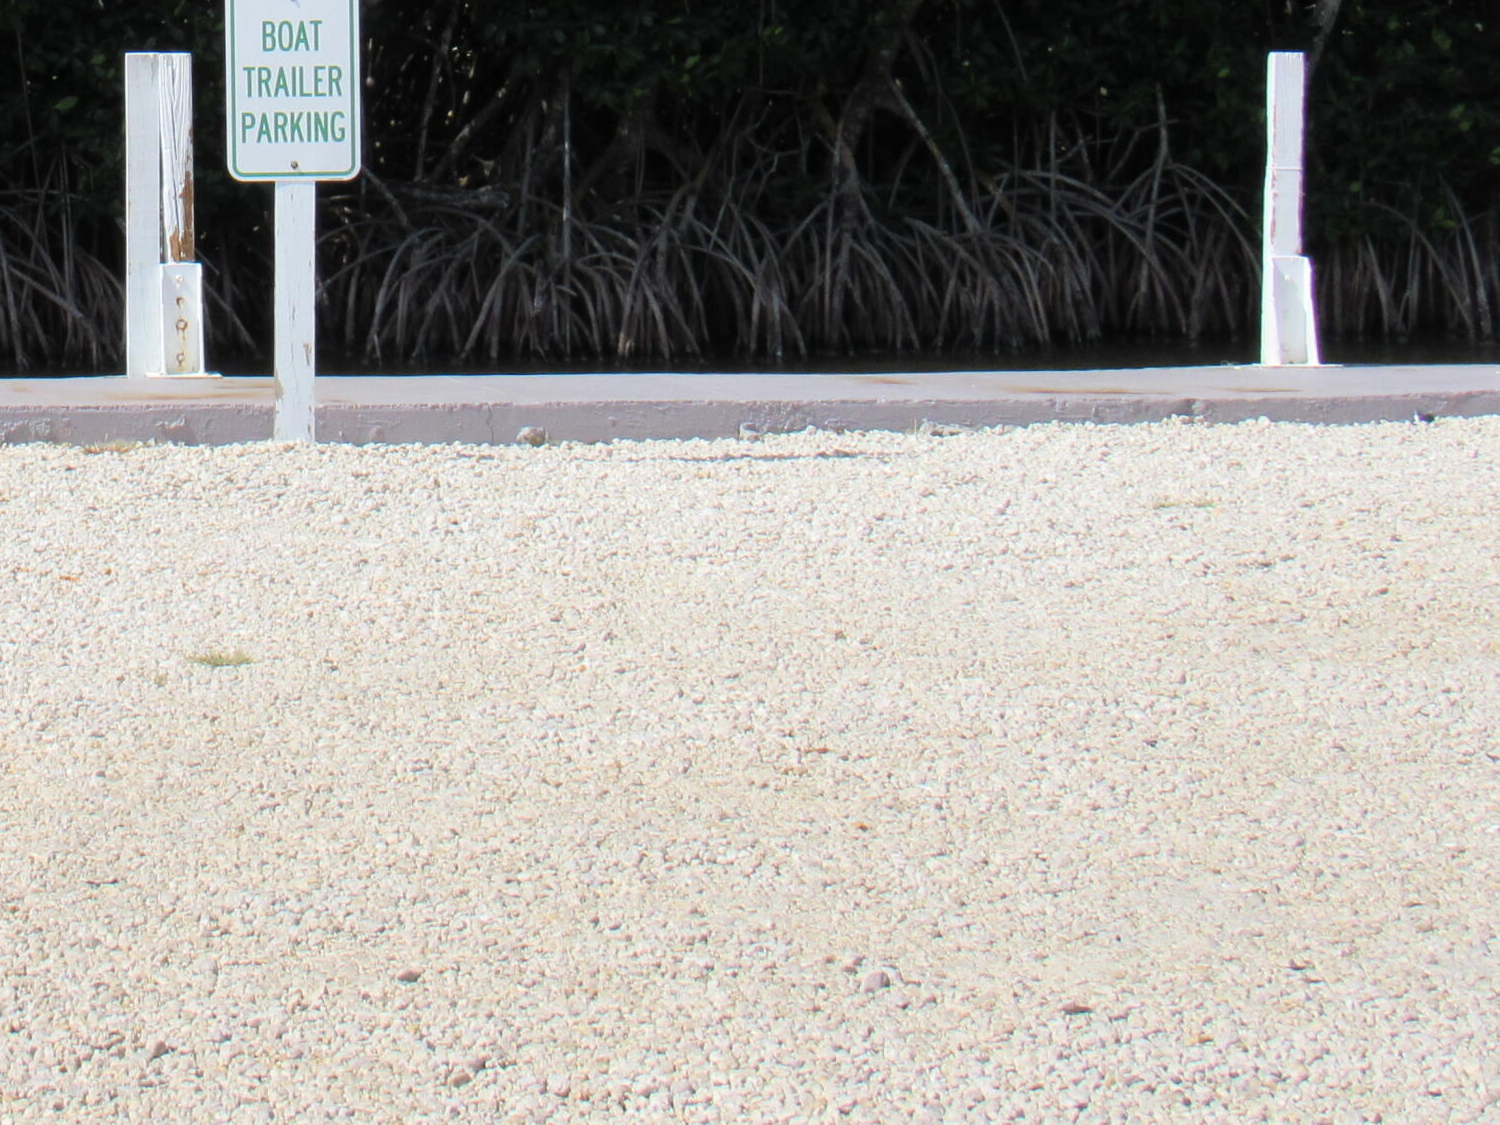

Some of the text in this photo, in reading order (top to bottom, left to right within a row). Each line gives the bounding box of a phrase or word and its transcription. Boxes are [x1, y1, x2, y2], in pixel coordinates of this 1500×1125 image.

[262, 20, 322, 52] BOAT
[243, 66, 342, 98] TRAILER
[241, 111, 346, 143] PARKING
